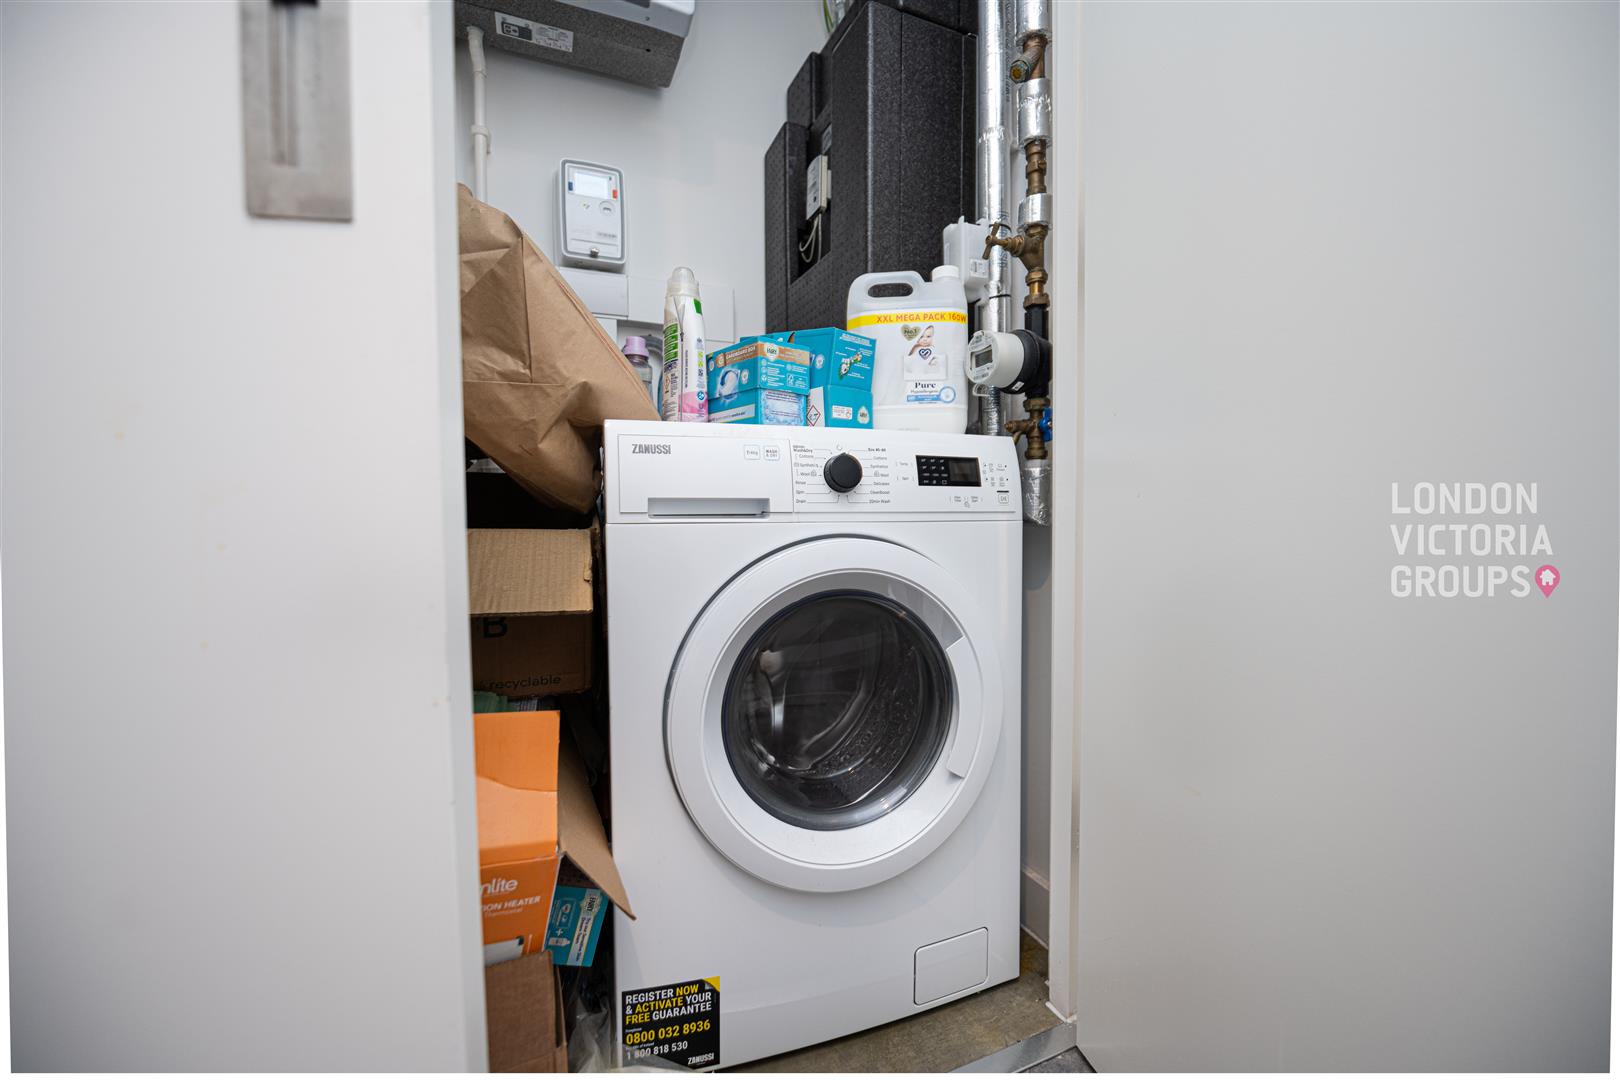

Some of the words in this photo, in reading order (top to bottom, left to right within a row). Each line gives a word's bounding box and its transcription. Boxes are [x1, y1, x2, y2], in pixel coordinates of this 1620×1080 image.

[876, 315, 894, 323] XXL
[896, 314, 921, 322] MEGA
[923, 313, 946, 321] PACK
[632, 444, 671, 455] ZANUSSI
[488, 674, 561, 690] recyclable
[503, 896, 541, 910] HEATER
[626, 988, 674, 1004] REGISTER
[676, 984, 699, 996] NOW
[626, 1005, 632, 1014] &
[635, 997, 683, 1013] ACTIVATE
[685, 992, 711, 1004] YOUR
[625, 1012, 650, 1025] FREE
[652, 1001, 712, 1020] GUARANTEE
[626, 1030, 655, 1045] 0800
[658, 1025, 680, 1039] 032
[683, 1019, 711, 1034] 8936
[654, 1045, 669, 1055] 818
[672, 1040, 688, 1052] 530
[688, 1052, 714, 1065] ZANUSSI
